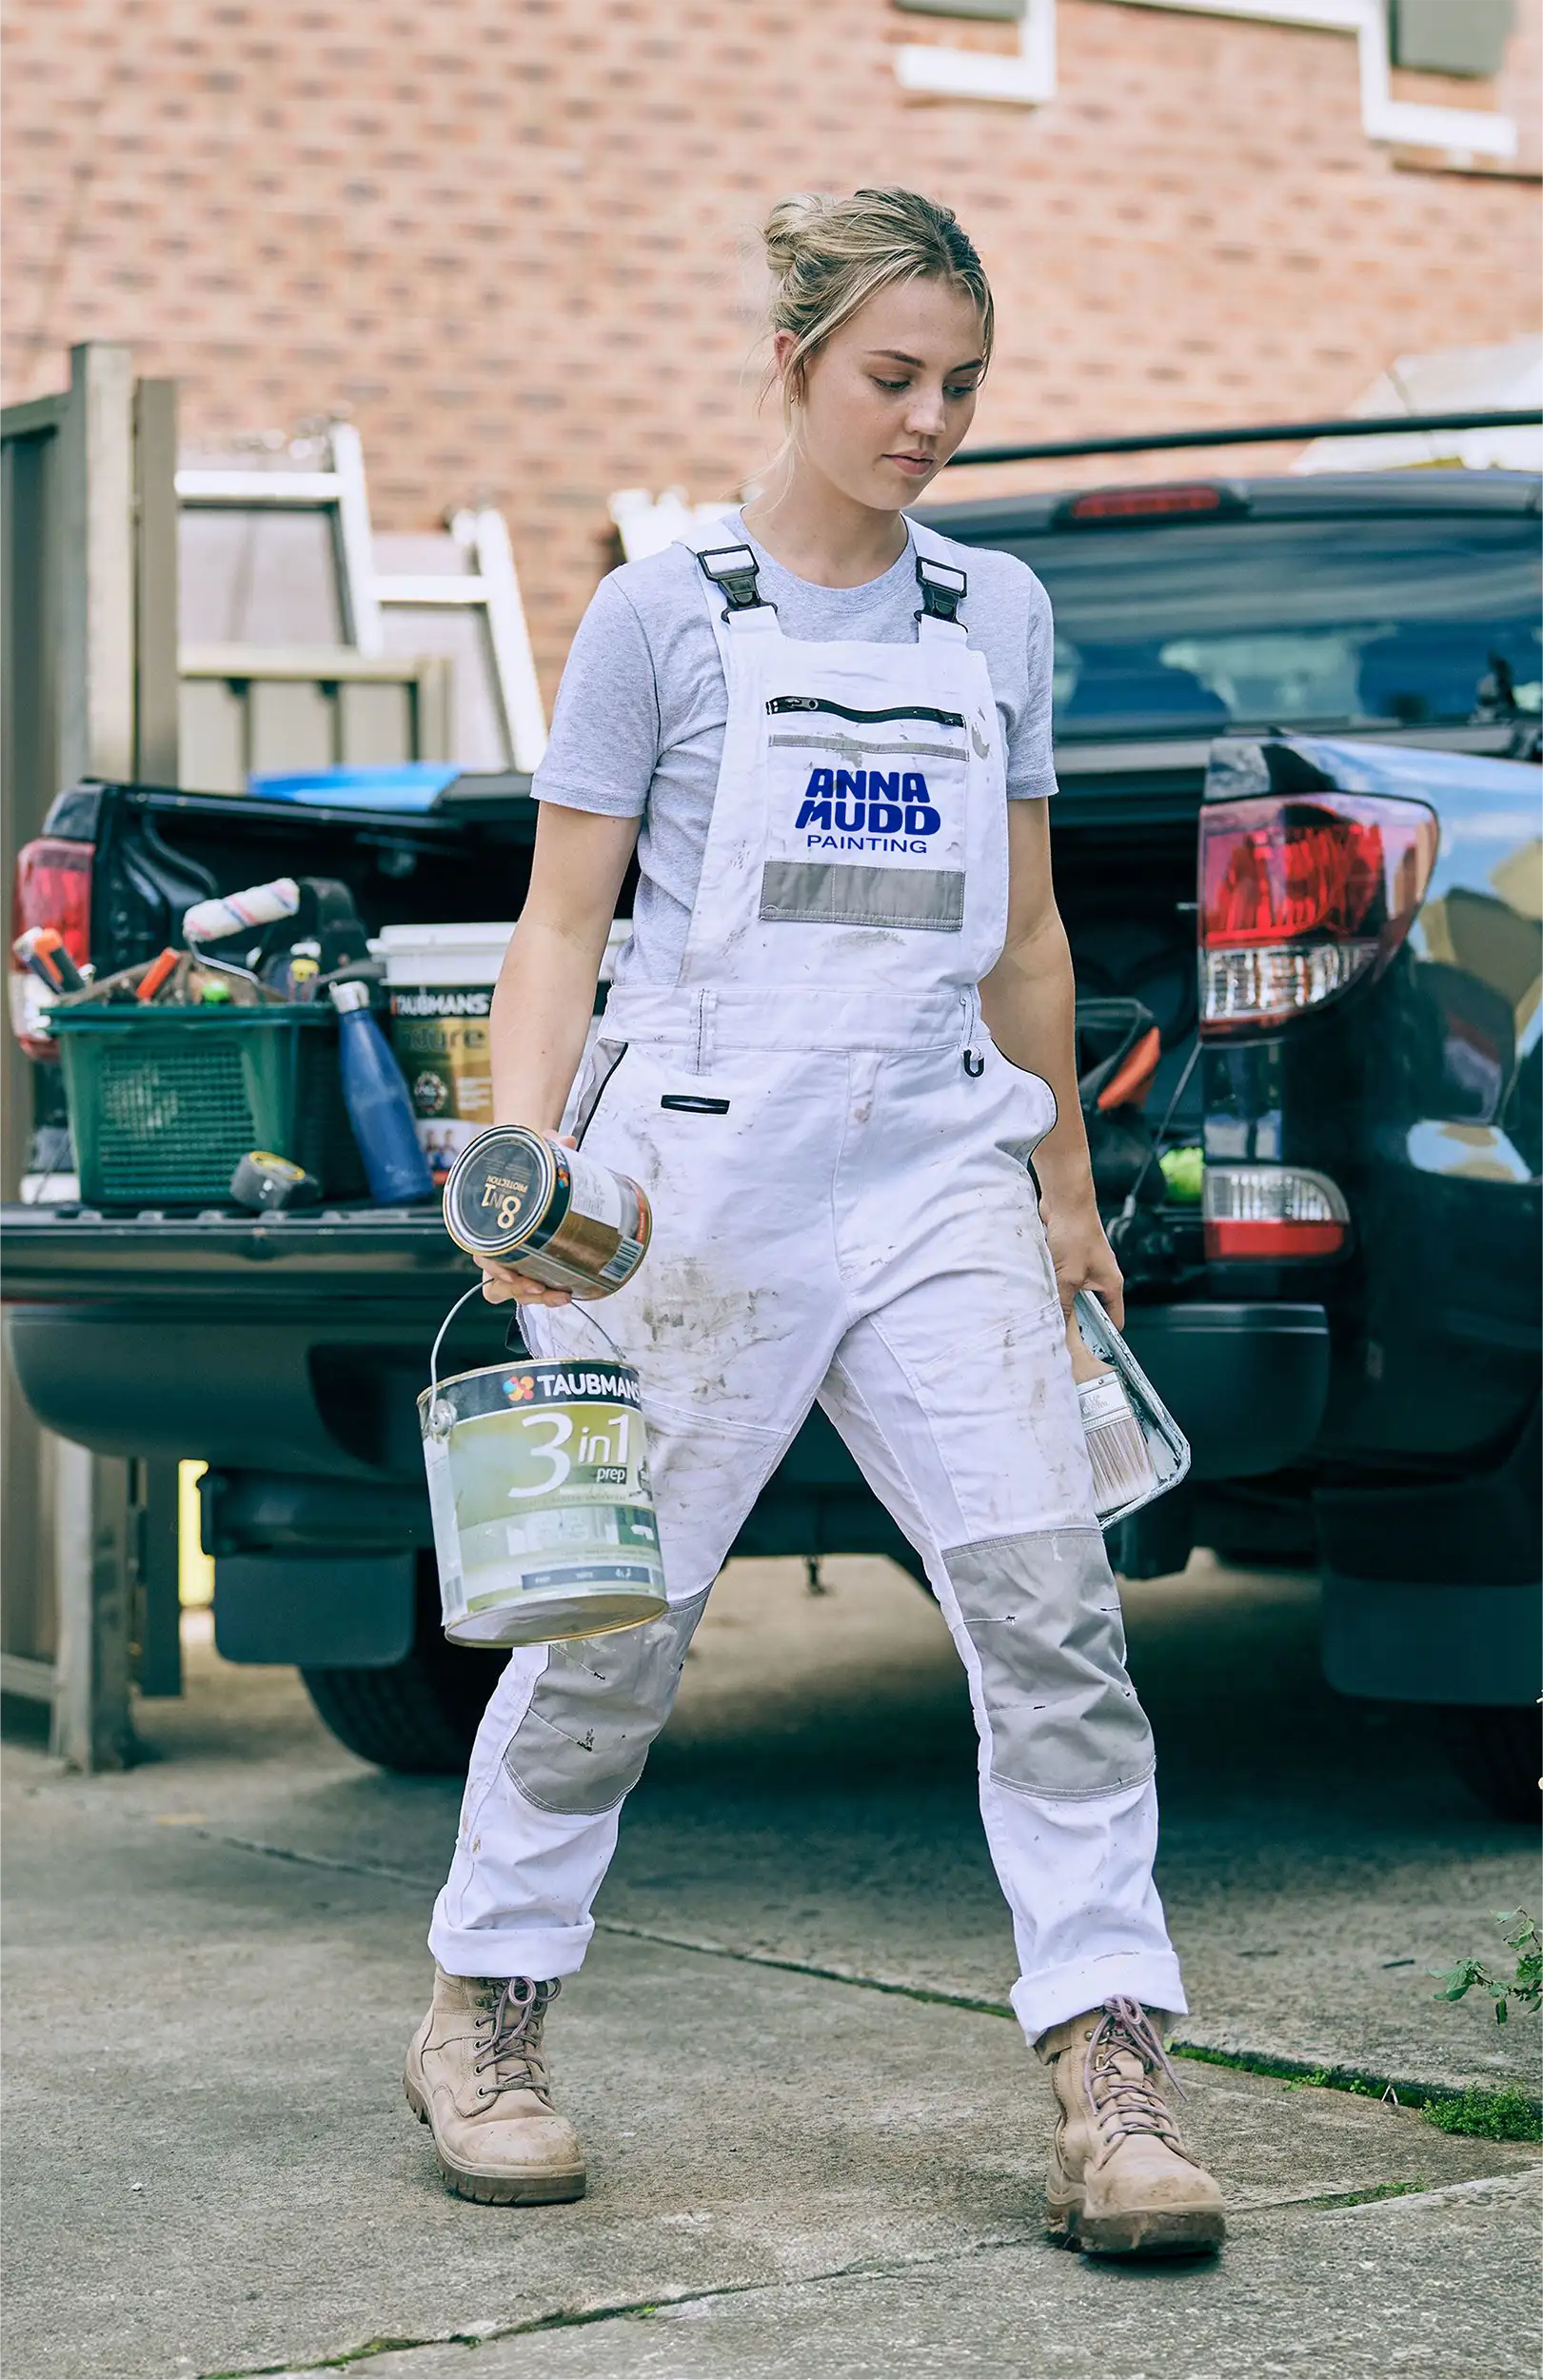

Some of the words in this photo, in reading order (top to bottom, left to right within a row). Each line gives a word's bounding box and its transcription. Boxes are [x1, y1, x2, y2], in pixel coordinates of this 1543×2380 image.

[805, 768, 931, 803] ANNA
[795, 800, 941, 836] MUDD
[807, 835, 927, 854] PAINTING
[485, 1174, 528, 1194] PROTECTION
[536, 1373, 641, 1403] TAUBMANS
[596, 1467, 625, 1483] prep
